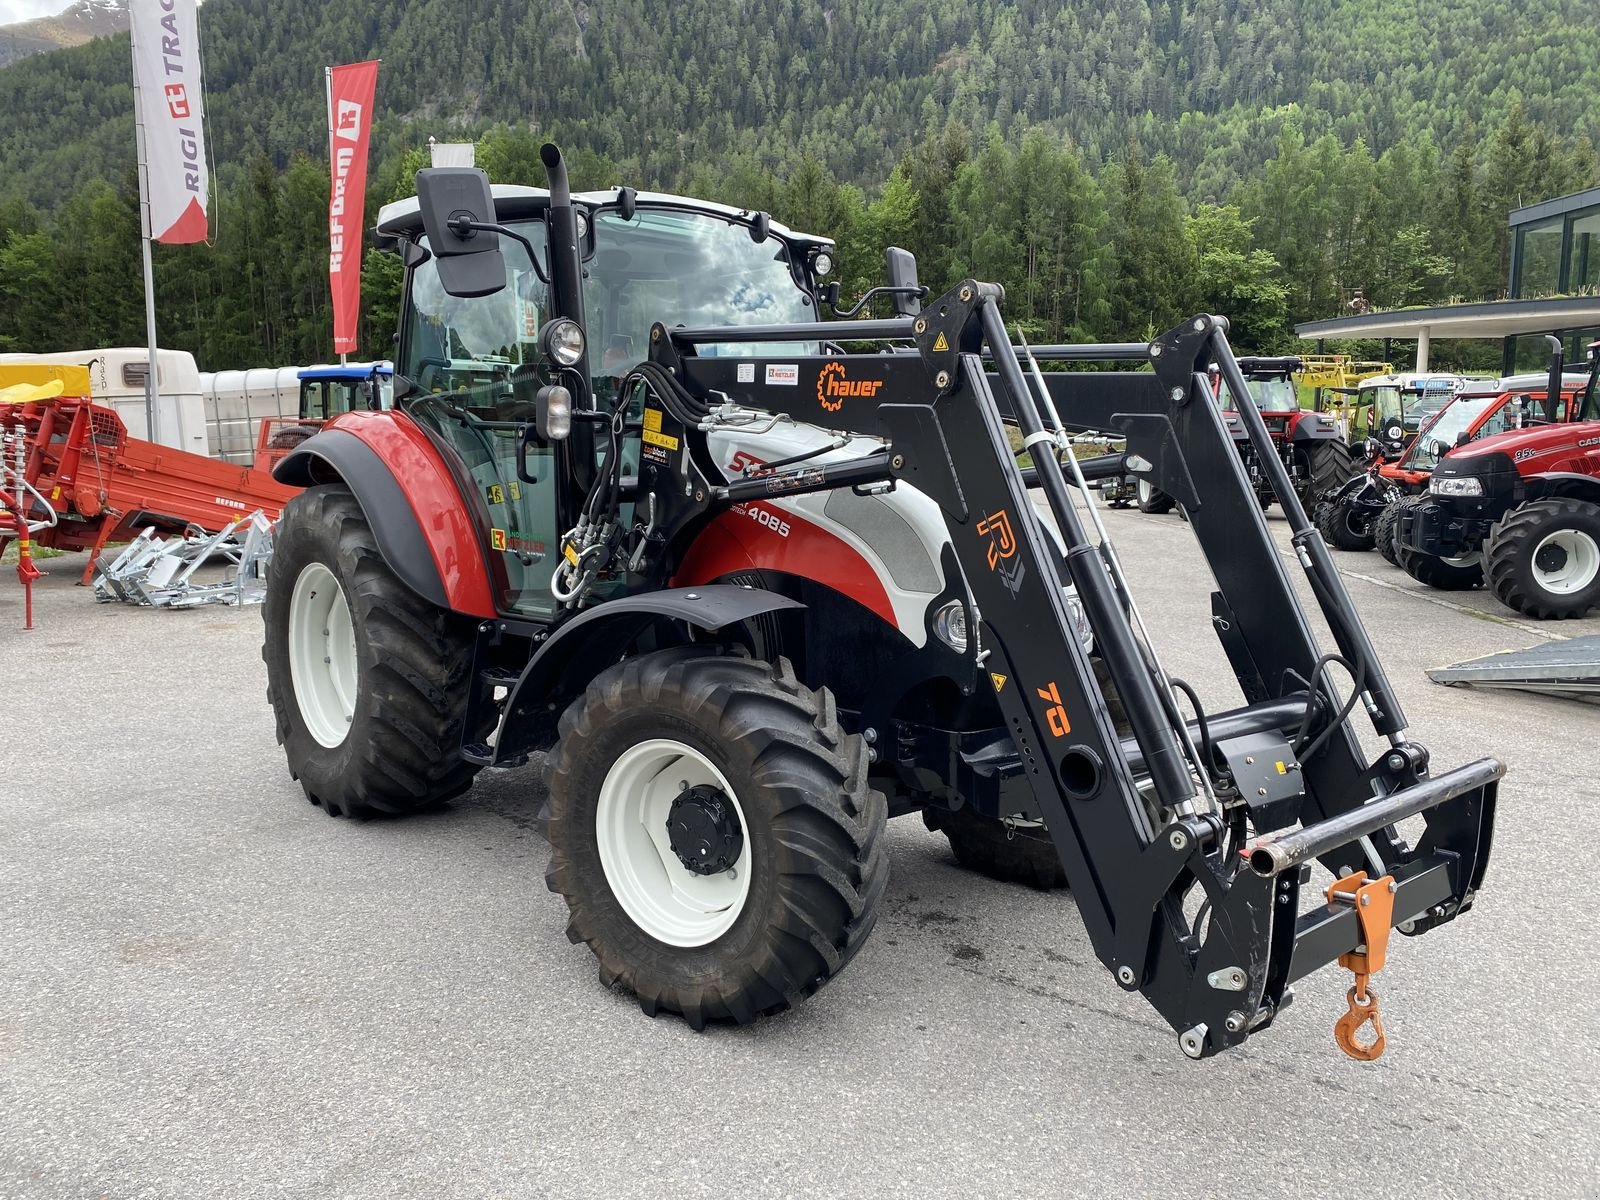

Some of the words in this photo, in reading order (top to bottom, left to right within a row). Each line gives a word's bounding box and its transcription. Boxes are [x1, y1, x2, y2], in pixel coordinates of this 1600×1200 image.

[179, 127, 199, 192] RIGI
[827, 373, 883, 397] hauer
[1390, 428, 1400, 437] 40
[748, 507, 791, 538] 4085
[1036, 682, 1071, 737] 70
